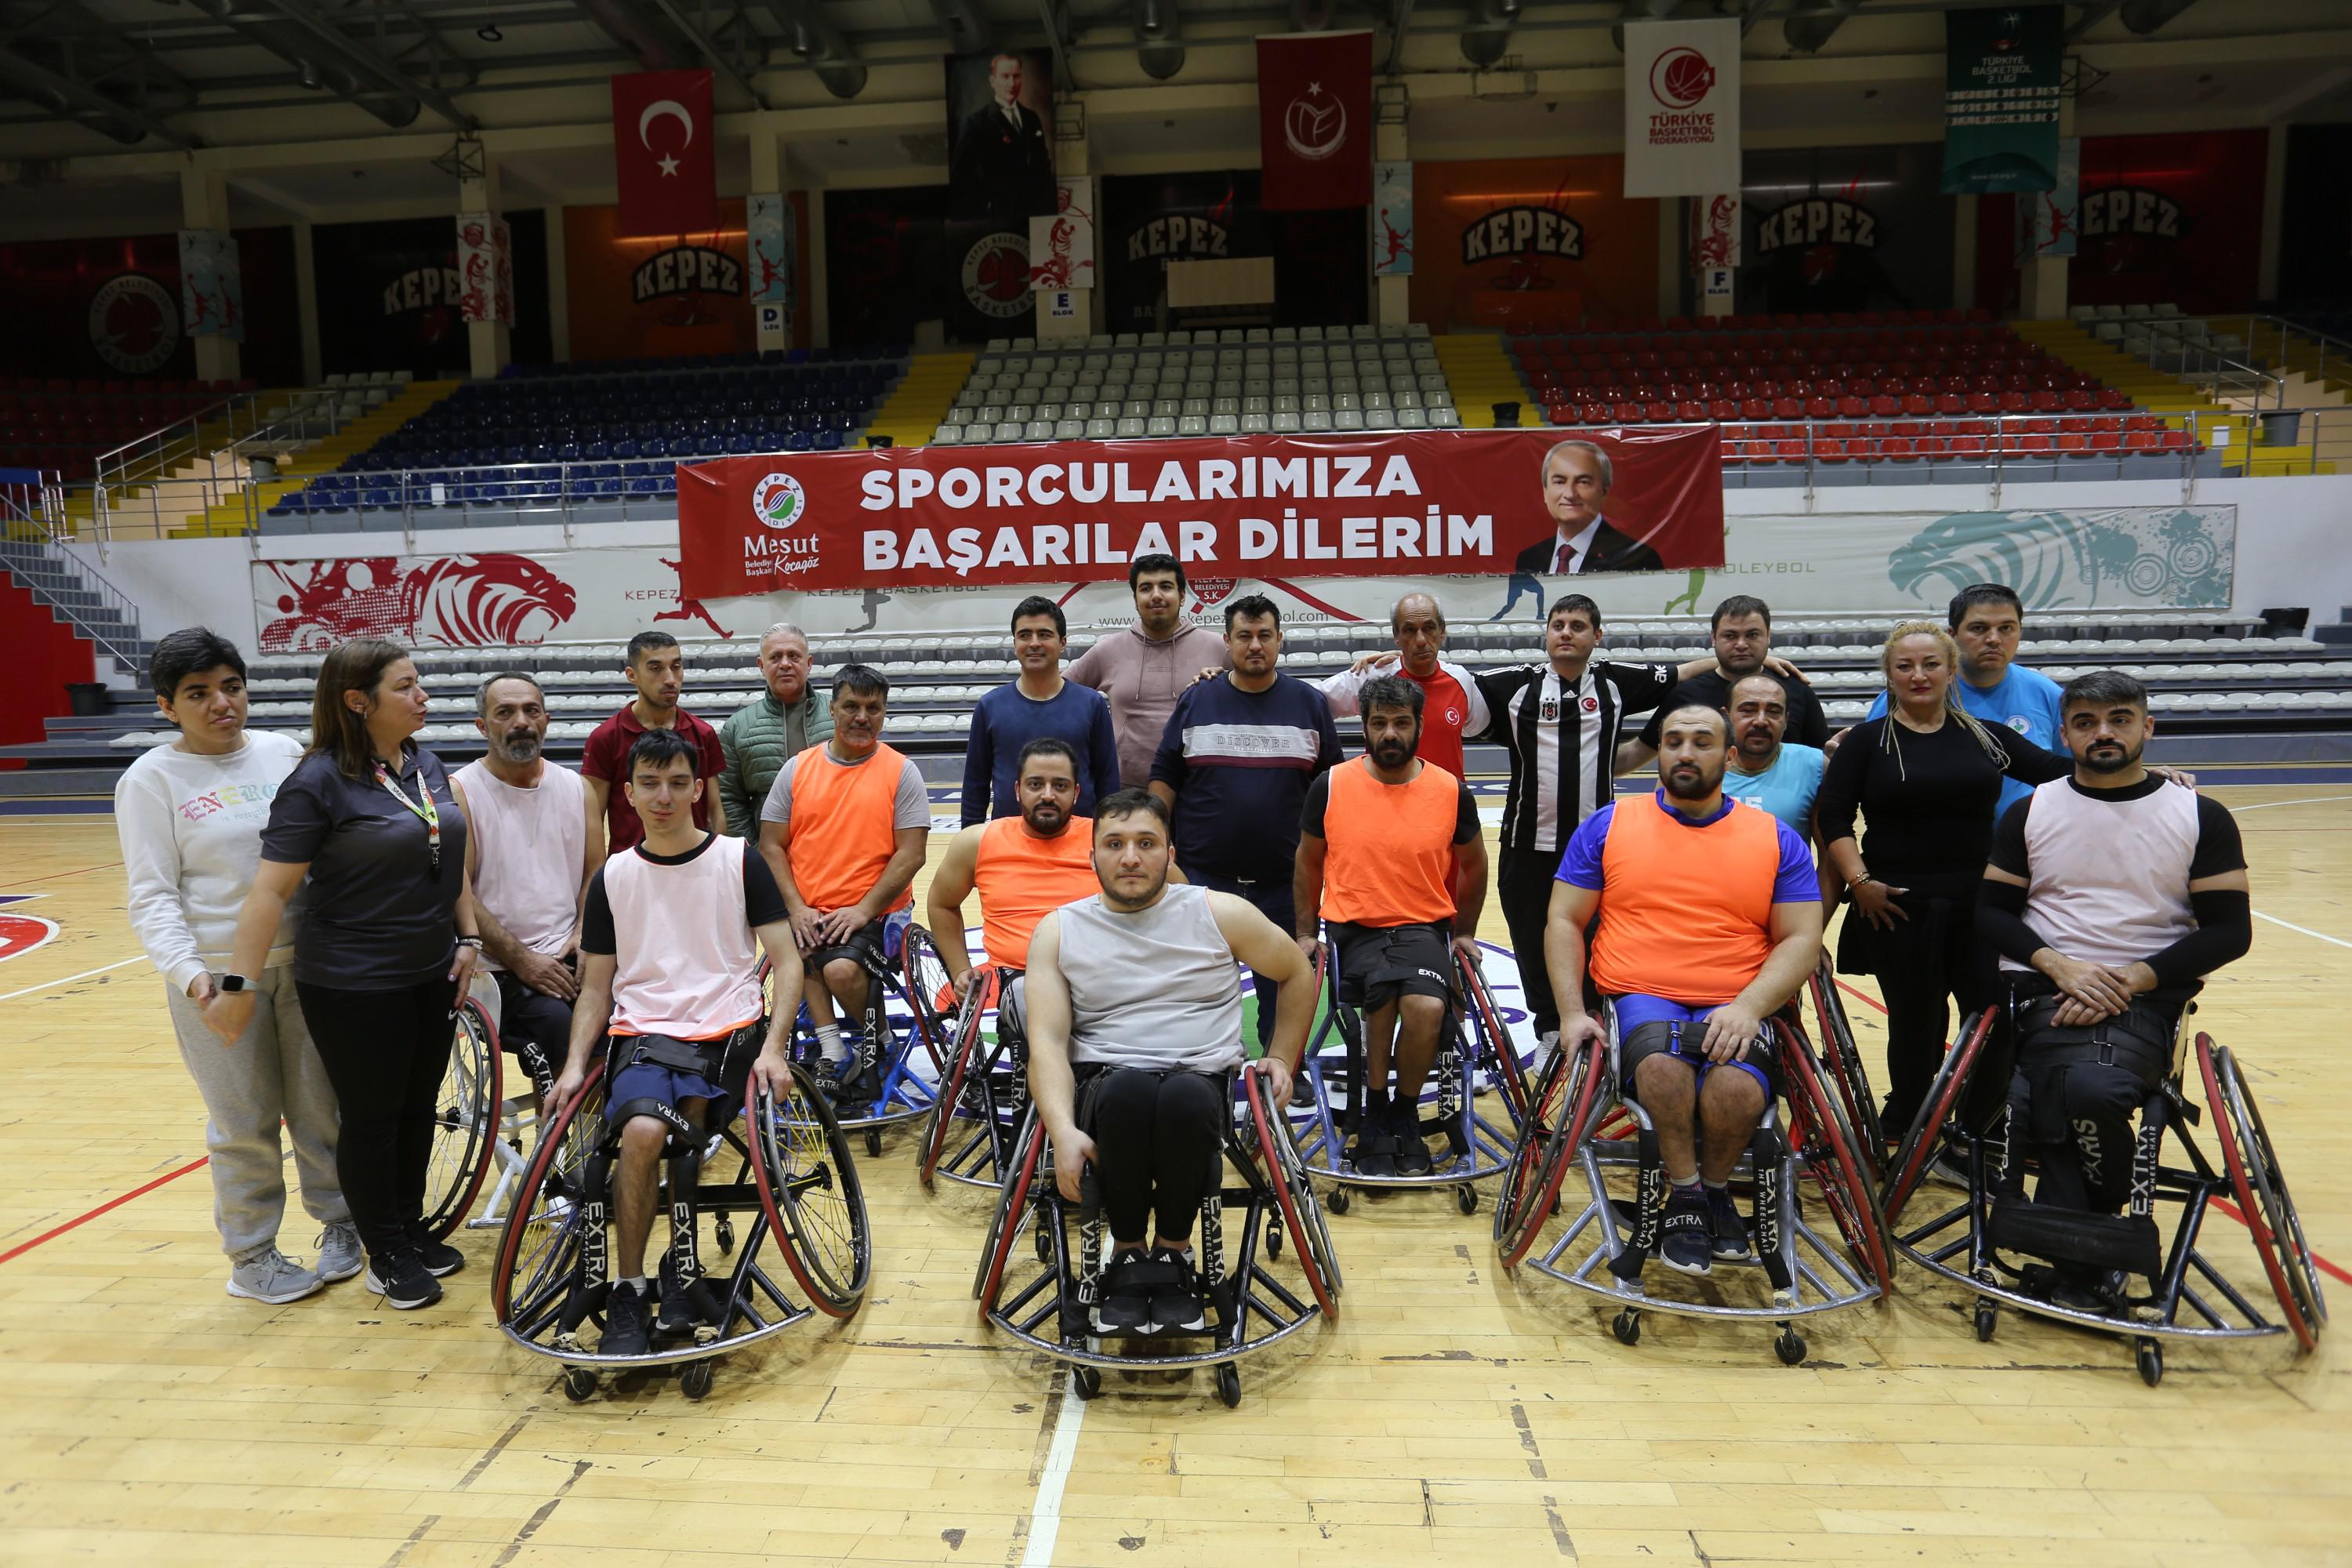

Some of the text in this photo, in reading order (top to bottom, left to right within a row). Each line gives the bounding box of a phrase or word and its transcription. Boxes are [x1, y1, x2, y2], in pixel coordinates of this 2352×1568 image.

[1971, 64, 2033, 76] BASKETBOL
[1650, 111, 1715, 126] TÜRKİYE
[1650, 125, 1715, 137] BASKETBOL
[1649, 136, 1715, 145] FEDERASYONU
[1467, 209, 1580, 261] KEPEZ
[1759, 201, 1875, 252] KEPEZ
[2082, 189, 2180, 238] EPEZ
[1129, 216, 1228, 263] KEPEZ
[383, 267, 461, 317] KEPE
[636, 249, 740, 303] KEPEZ
[1715, 272, 1726, 286] F
[764, 308, 778, 322] D
[965, 286, 1036, 315] BASKETBO
[1058, 293, 1069, 307] E
[757, 475, 800, 498] KEPEZ
[859, 454, 1422, 511] SPORCULARIMIZA
[744, 533, 819, 557] Mesut
[863, 503, 1494, 578] BAŞARILAR DİLERİM
[746, 554, 820, 577] Başkan Kocagöz
[625, 589, 678, 601] KEPEZ
[1203, 591, 1221, 600] S.K.
[1216, 735, 1291, 749] DISCOVER
[178, 783, 279, 823] ENERG
[1417, 968, 1447, 987] EXTRA
[737, 1024, 757, 1047] EXTRA
[864, 1007, 877, 1069] EXTRA
[1753, 1038, 1769, 1056] TRA
[526, 1042, 554, 1100] EXTR
[815, 1078, 840, 1091] EXTRA
[1012, 1061, 1028, 1113] XTRA
[1442, 1051, 1455, 1121] EXTRA
[657, 1102, 690, 1131] EXTRA
[2072, 1118, 2103, 1185] PARIS
[2130, 1125, 2149, 1215] EXTRA
[1664, 1214, 1703, 1229] EXTRA
[1759, 1191, 1771, 1254] WHEELCHAIR
[1765, 1168, 1779, 1254] EXTRA
[588, 1201, 605, 1290] EXTRA
[673, 1202, 696, 1291] EXTRA
[1203, 1221, 1216, 1287] WHEELCHAIR
[1210, 1195, 1226, 1286] EXTRA
[1078, 1220, 1098, 1305] EXTRA
